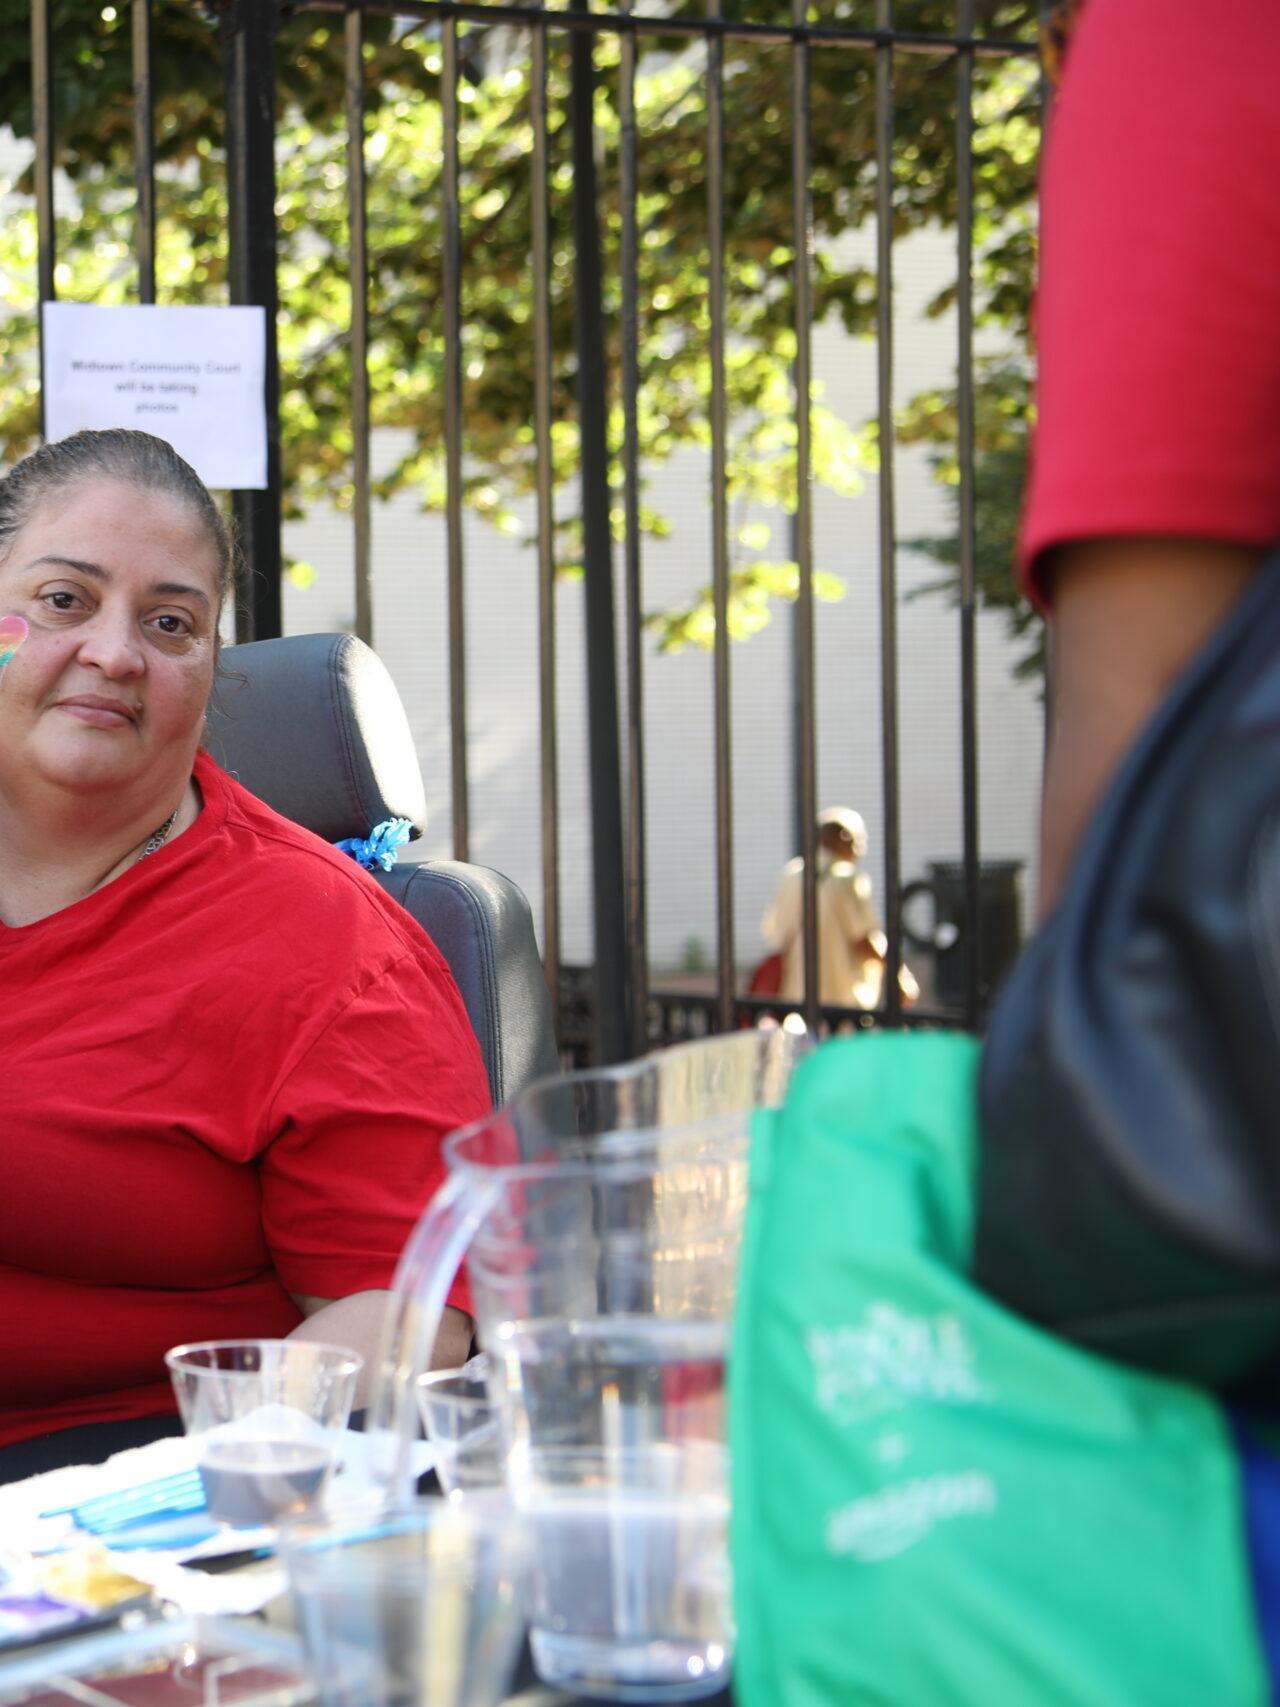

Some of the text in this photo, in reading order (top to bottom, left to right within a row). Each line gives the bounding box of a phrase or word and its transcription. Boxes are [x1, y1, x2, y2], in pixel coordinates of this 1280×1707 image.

[71, 360, 241, 374] Midtown Community Court
[115, 381, 198, 395] will be taking
[136, 402, 178, 413] photos
